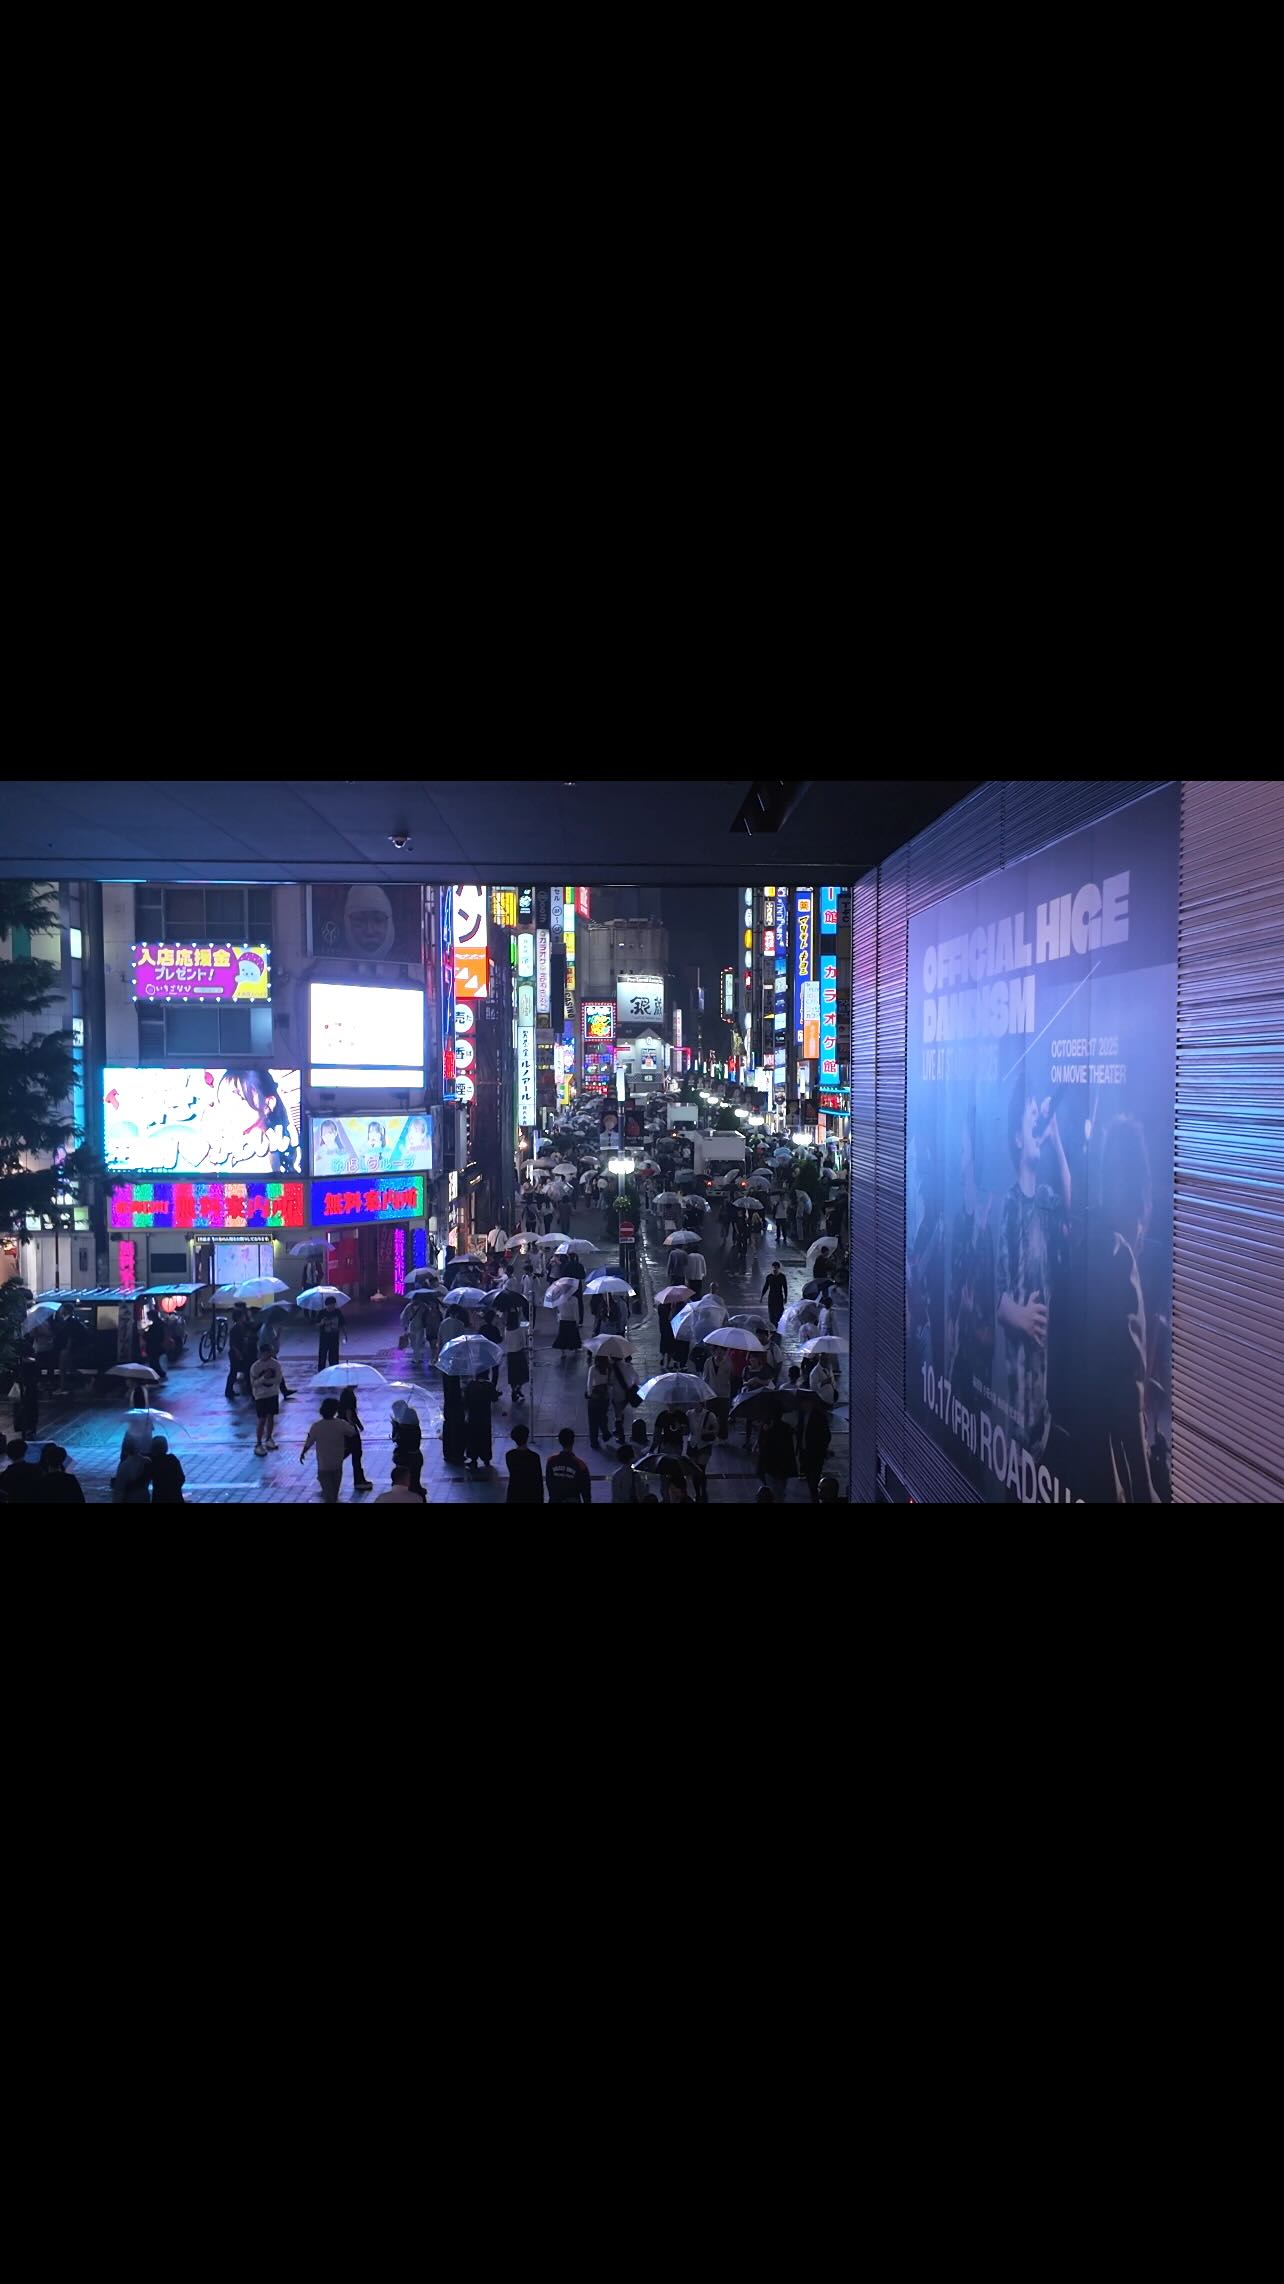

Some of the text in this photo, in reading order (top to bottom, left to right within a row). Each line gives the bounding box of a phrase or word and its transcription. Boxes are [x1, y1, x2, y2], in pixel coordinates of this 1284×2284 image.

[138, 949, 231, 967] 入店応援金
[923, 912, 1032, 993] OFFICIAL
[823, 966, 837, 1073] カラオケ館
[1051, 1064, 1127, 1084] ON MOVIE THEATER
